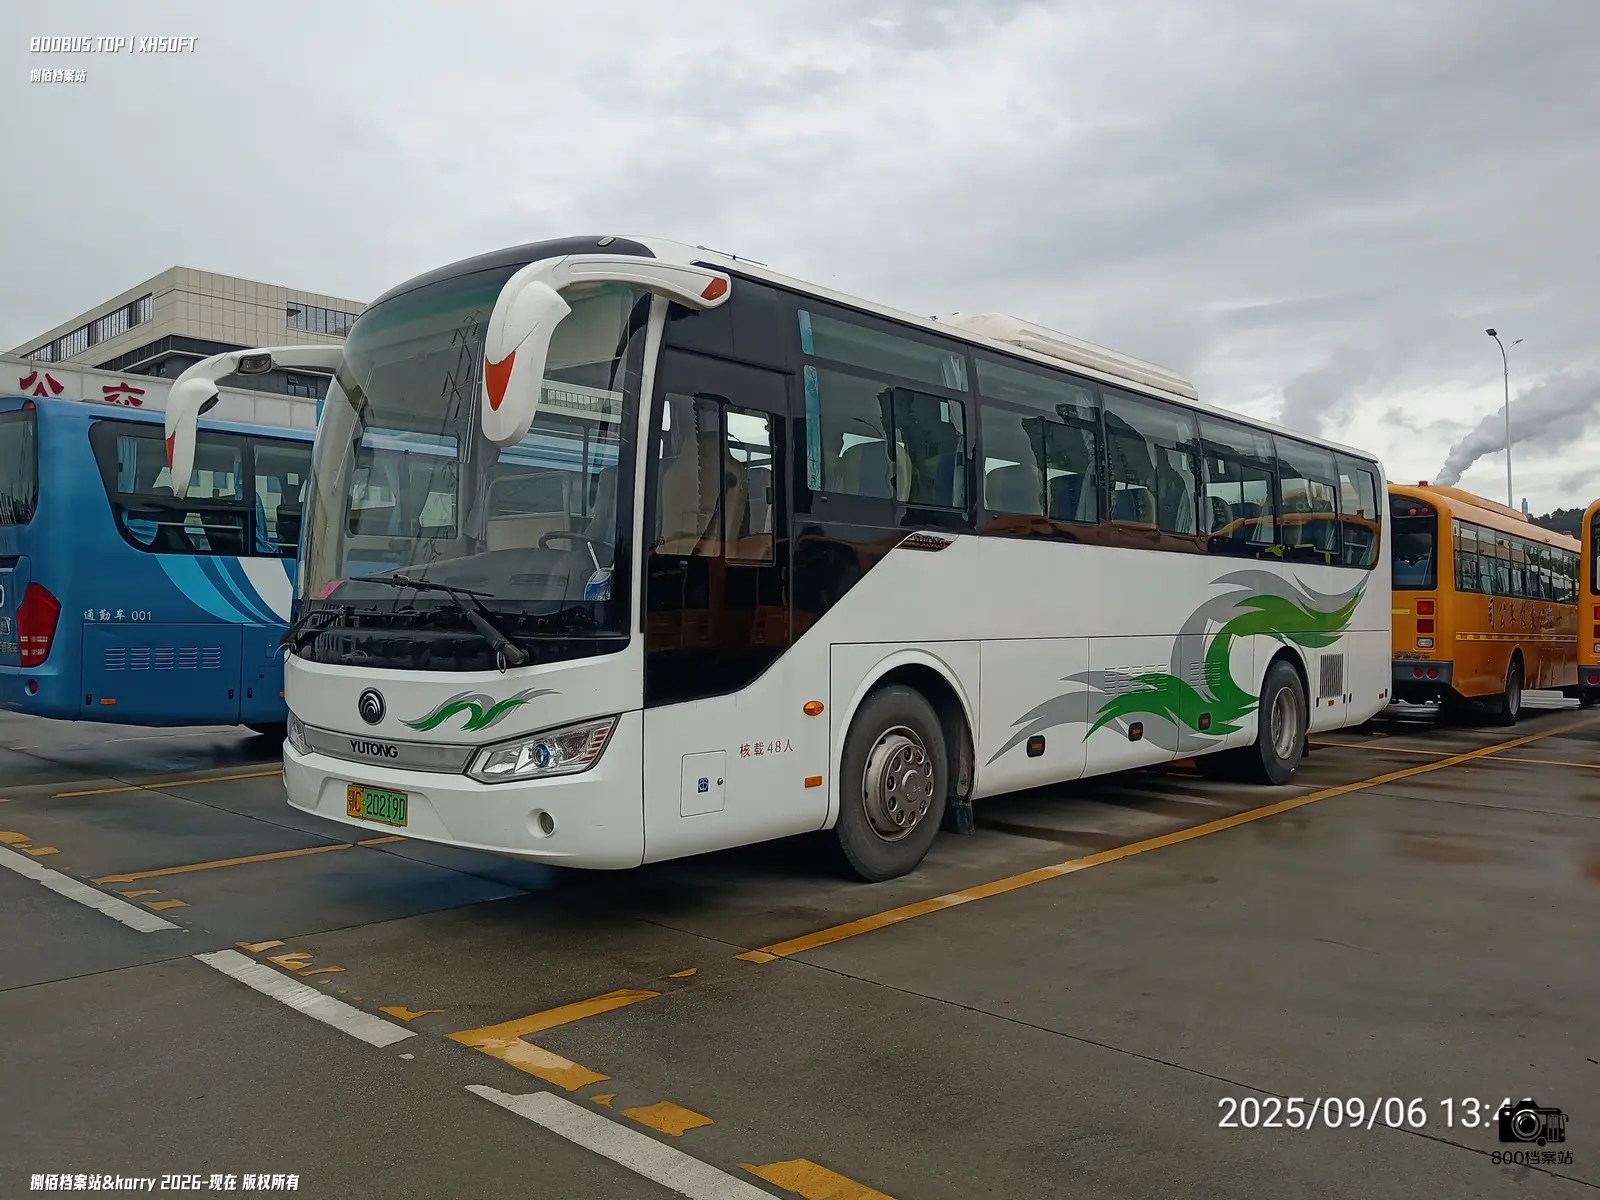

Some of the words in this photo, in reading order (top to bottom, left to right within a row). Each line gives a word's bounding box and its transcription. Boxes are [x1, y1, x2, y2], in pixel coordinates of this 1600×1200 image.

[83, 608, 126, 621] 通勤车
[131, 610, 152, 621] 001
[350, 739, 398, 758] YUTONG
[739, 738, 794, 759] 核载48人
